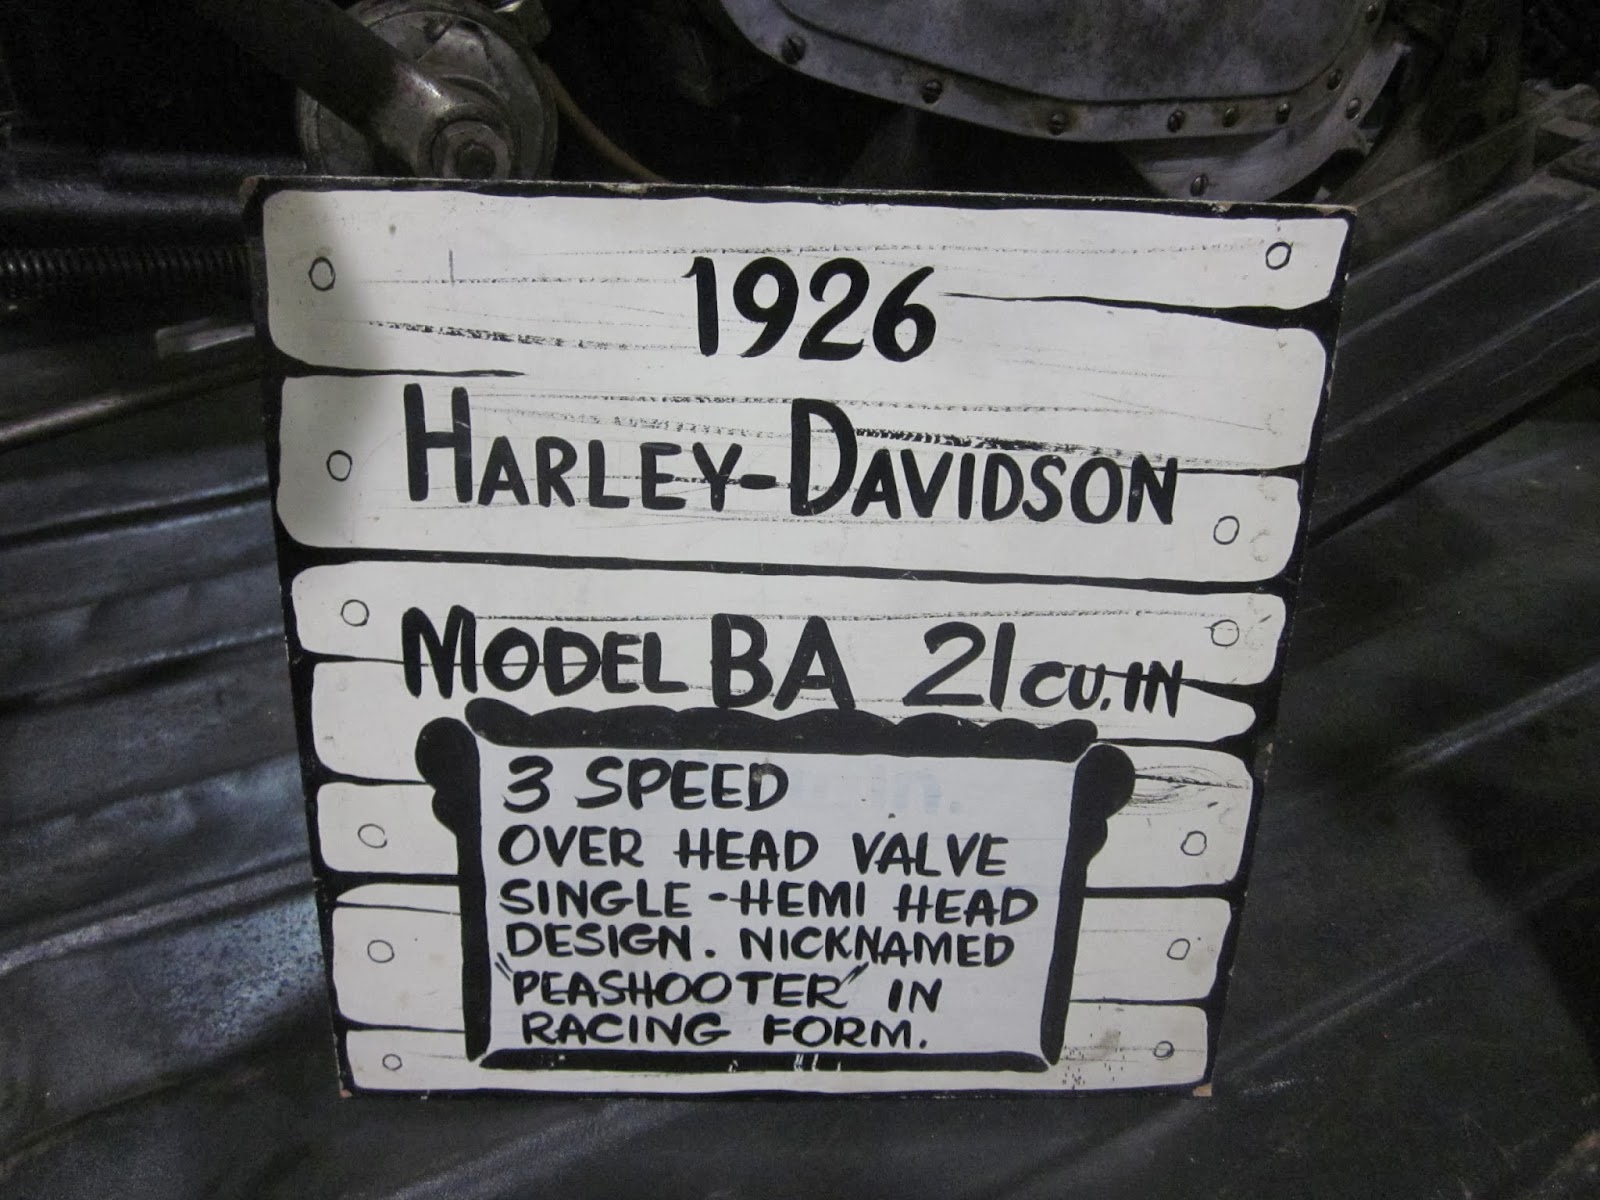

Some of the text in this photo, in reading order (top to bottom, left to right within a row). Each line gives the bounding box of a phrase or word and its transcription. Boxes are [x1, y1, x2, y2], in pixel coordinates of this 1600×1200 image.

[684, 256, 937, 362] 1926
[402, 382, 1178, 526] HARLEY-DAVIDSON
[401, 604, 690, 699] MODEL
[711, 612, 857, 711] BA
[503, 755, 553, 813] 3
[575, 756, 789, 812] SPEED
[499, 824, 1010, 878] OVER HEAD VALVE
[500, 878, 693, 919] SINGLE
[893, 886, 1039, 926] HEAD
[740, 925, 1016, 968] NICKNAMED
[888, 978, 943, 1014] IN
[521, 1011, 928, 1051] RACING FORM.
